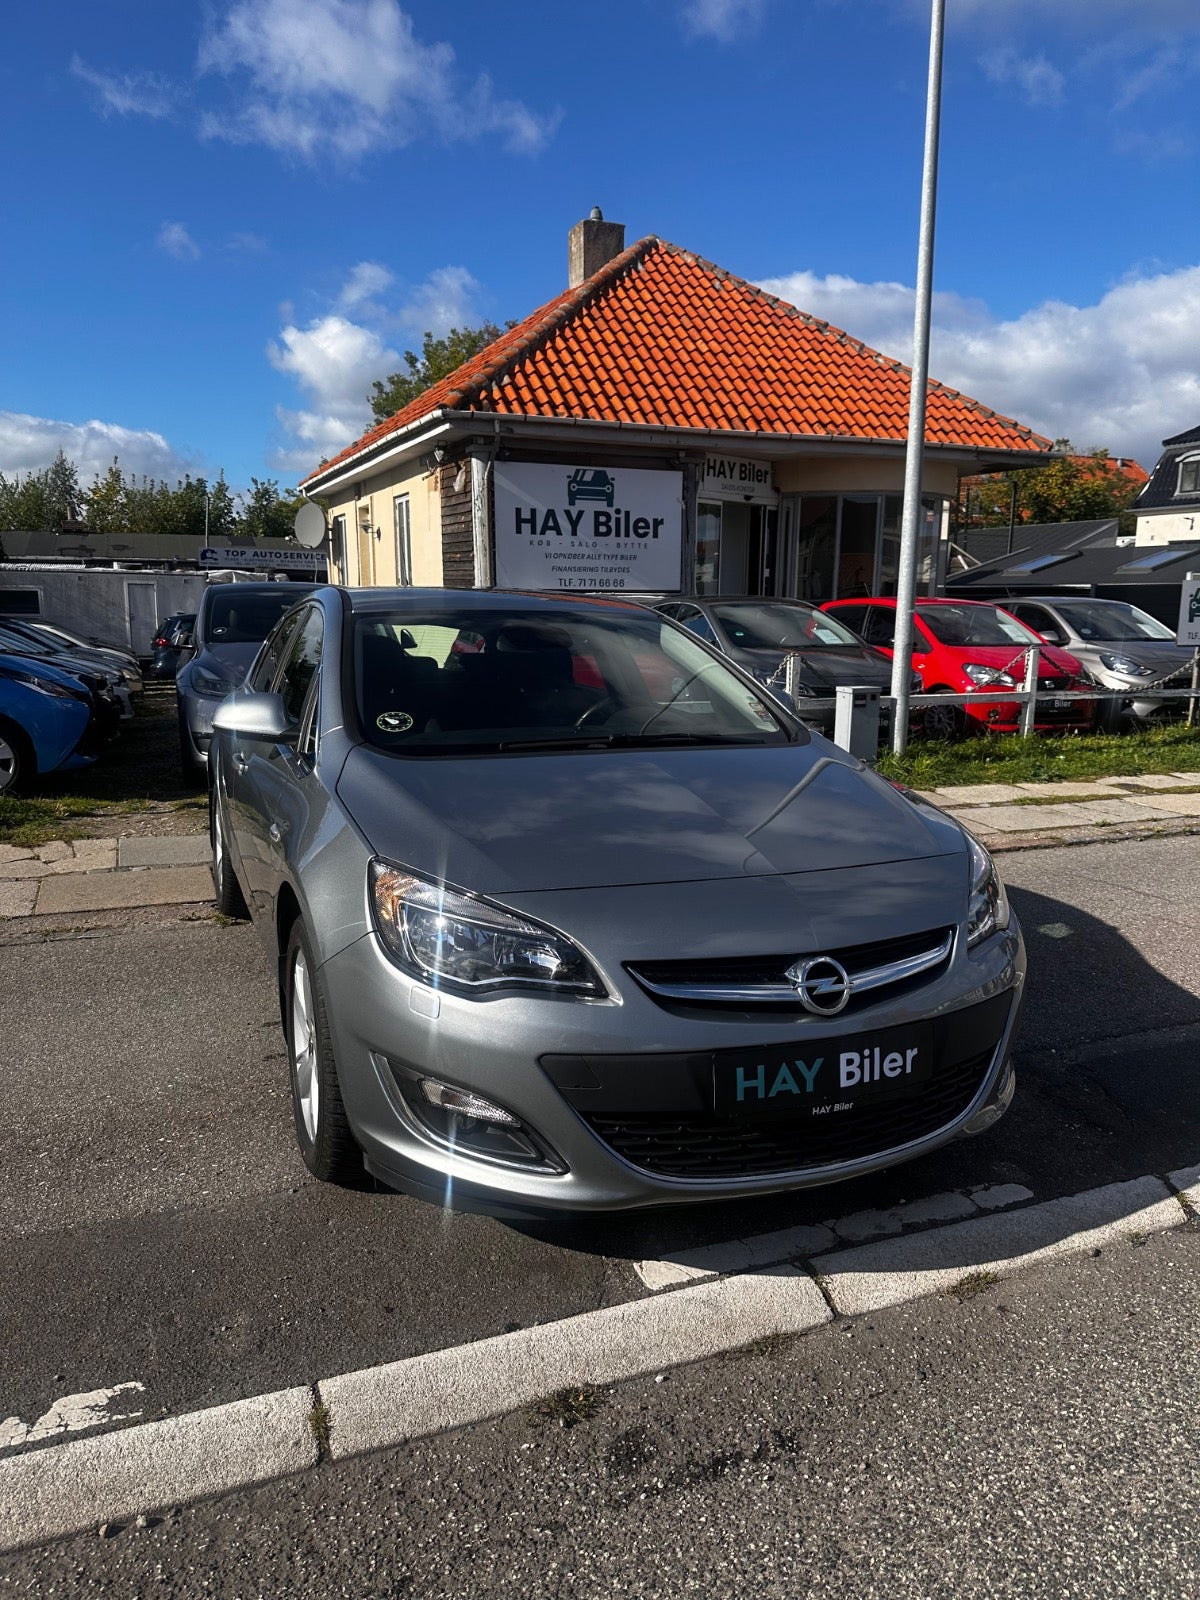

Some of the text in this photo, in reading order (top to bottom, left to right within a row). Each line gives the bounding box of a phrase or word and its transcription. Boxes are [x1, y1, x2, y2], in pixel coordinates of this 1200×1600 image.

[706, 458, 769, 484] HAY Biler
[515, 507, 664, 539] HAY Biler
[224, 549, 247, 558] TOP
[252, 550, 327, 561] AUTOSERVICE
[558, 578, 625, 588] TLF. 71 71 66 66
[1055, 700, 1071, 708] Biler
[736, 1046, 918, 1101] HAY Biler
[812, 1102, 854, 1116] HAY Biler
